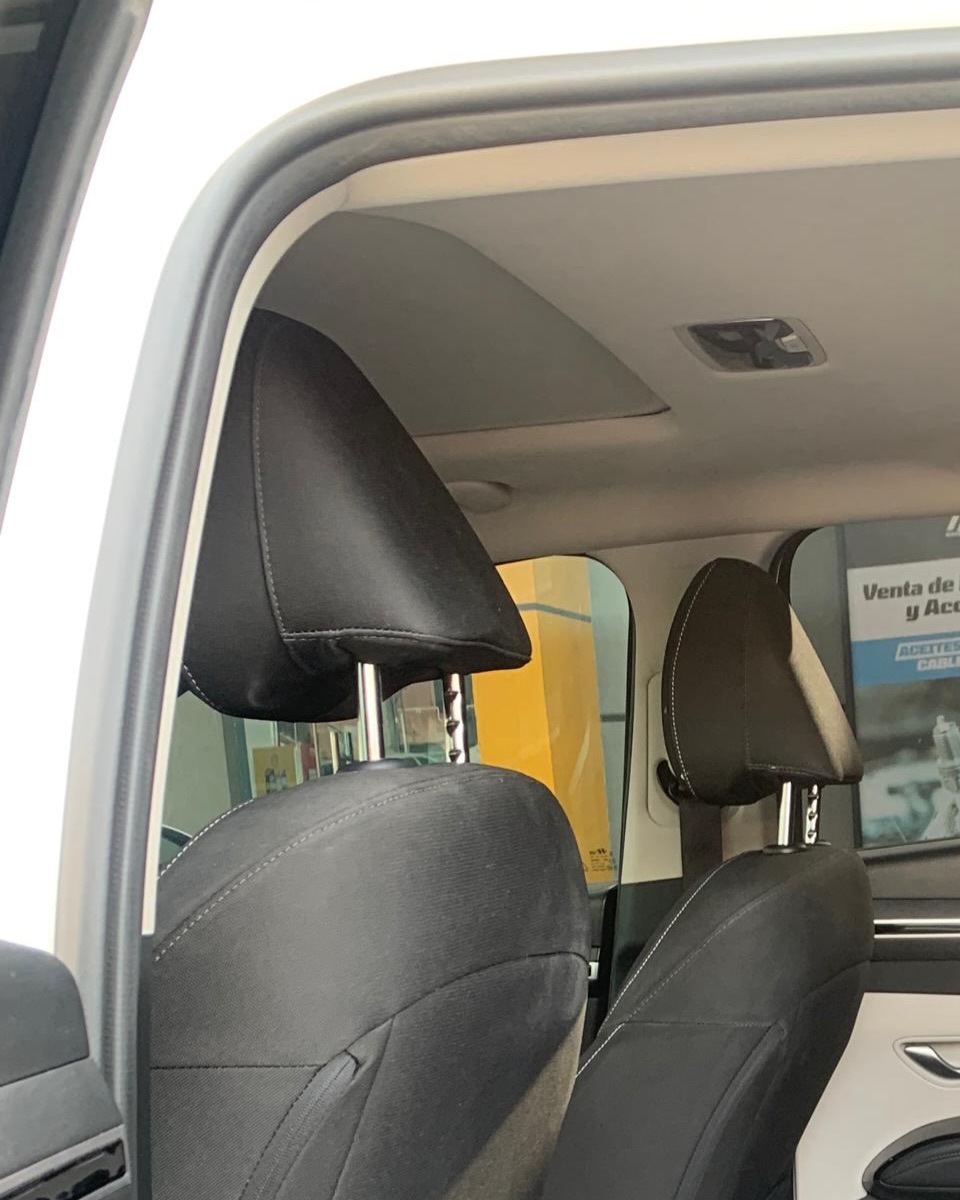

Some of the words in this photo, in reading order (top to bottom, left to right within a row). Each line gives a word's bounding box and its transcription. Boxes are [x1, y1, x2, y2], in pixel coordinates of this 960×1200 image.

[863, 581, 923, 600] Venta
[928, 576, 954, 593] de
[906, 605, 919, 622] y
